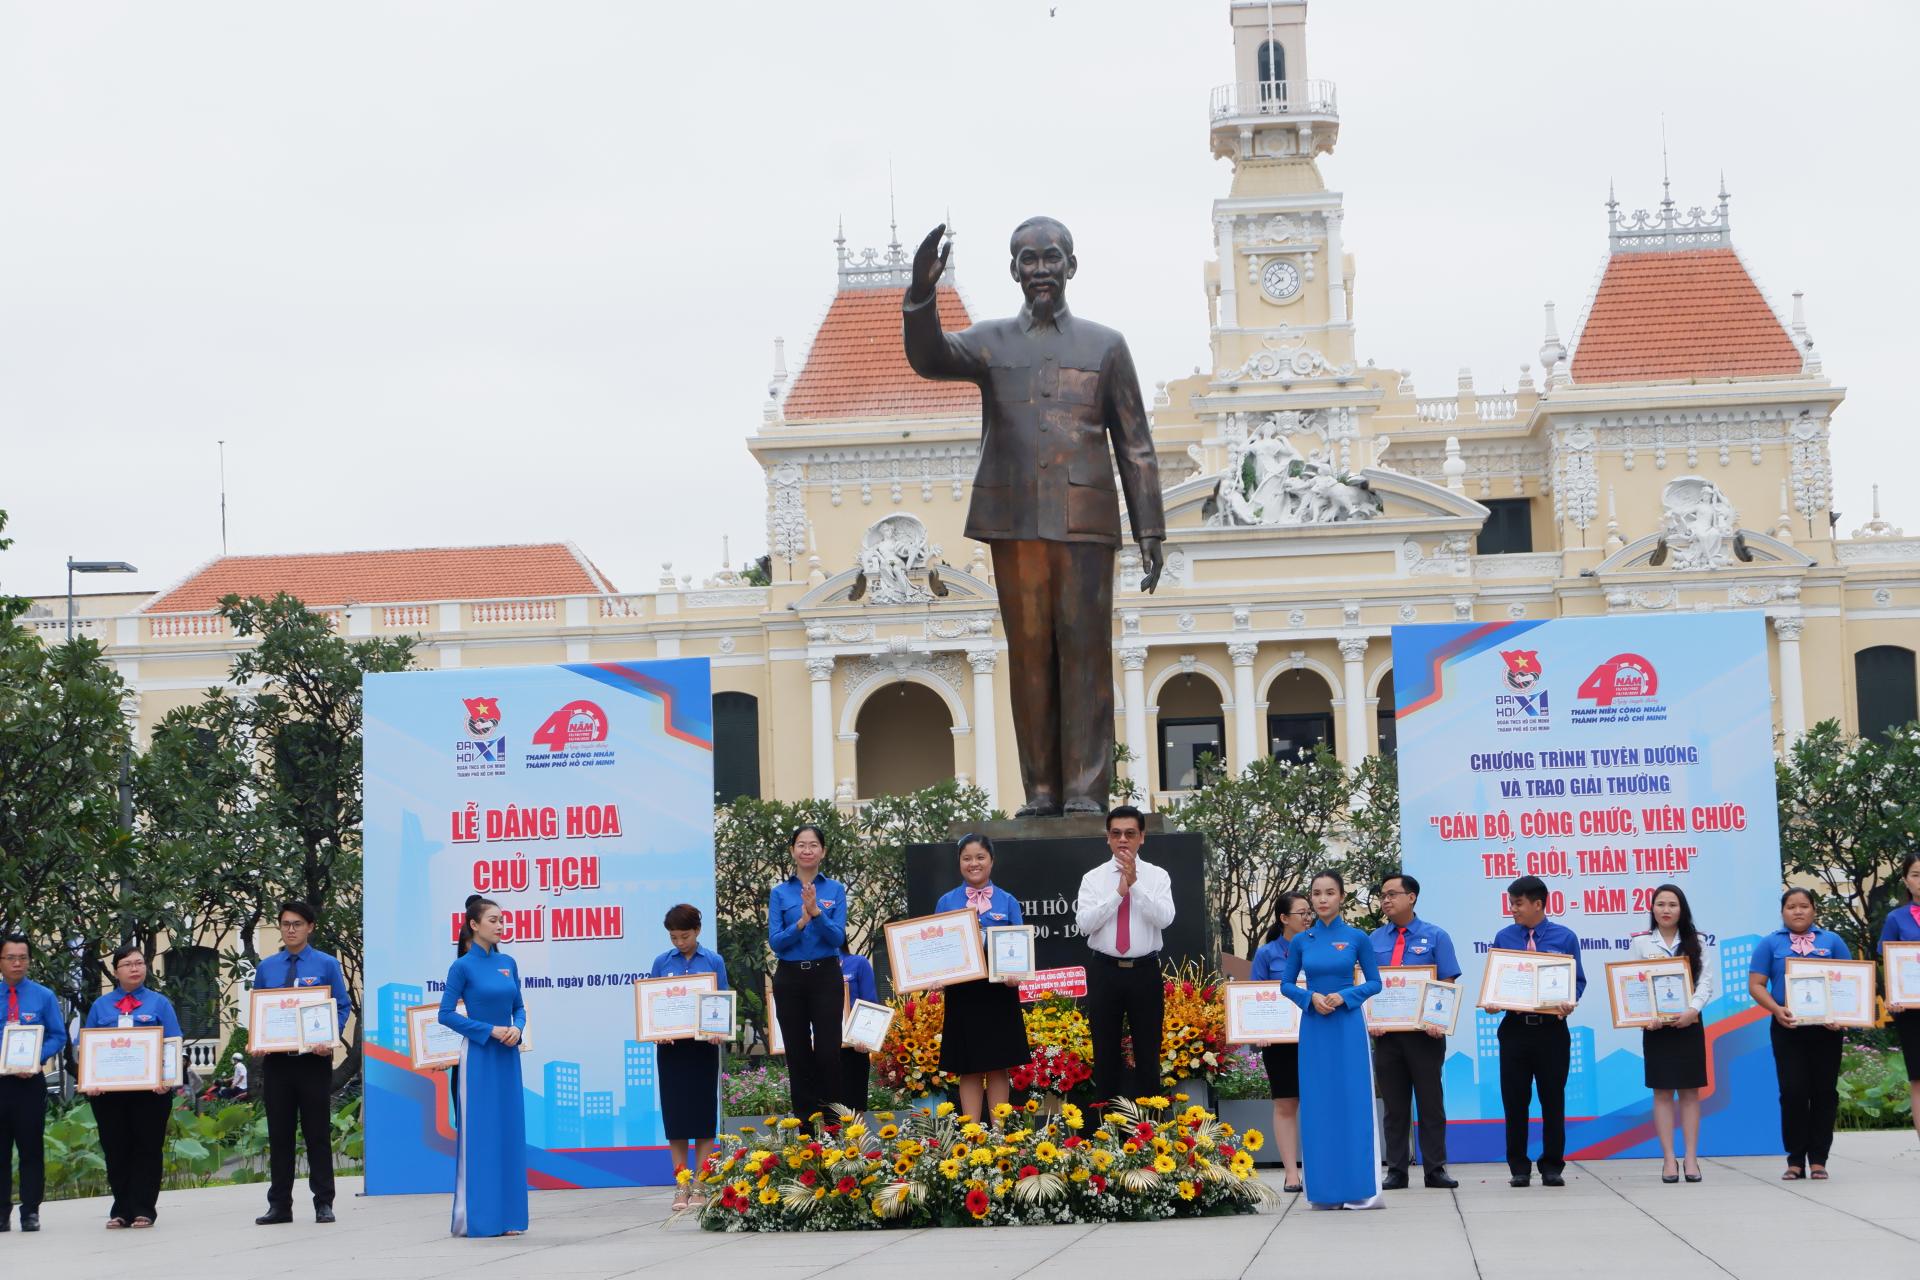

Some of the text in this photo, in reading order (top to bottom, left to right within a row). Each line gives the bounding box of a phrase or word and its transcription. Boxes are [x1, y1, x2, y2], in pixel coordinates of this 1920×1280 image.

[1571, 716, 1598, 724] THÀNH
[1470, 745, 1699, 771] CHƯƠNG TRÌNH TUYÊN DƯƠNG
[1500, 772, 1671, 798] VÀ TRAO GIẢI THƯỞNG
[451, 801, 622, 843] LỄ DÂNG HOA
[1430, 802, 1747, 842] "CÁN BỘ, CÔNG CHỨC, VIÊN CHỨC
[473, 851, 600, 896] CHỦ TỊCH
[1482, 843, 1698, 879] TRẺ, GIỎI, THÂN THIỆN"
[1043, 893, 1068, 916] HỒ
[1583, 885, 1628, 915] NĂM
[1632, 887, 1654, 914] 20
[551, 906, 623, 942] MINH
[1034, 925, 1049, 939] 90
[1580, 937, 1632, 950] Minh, ng
[426, 979, 447, 992] Thà
[525, 975, 554, 989] Minh,
[557, 974, 584, 988] ngày
